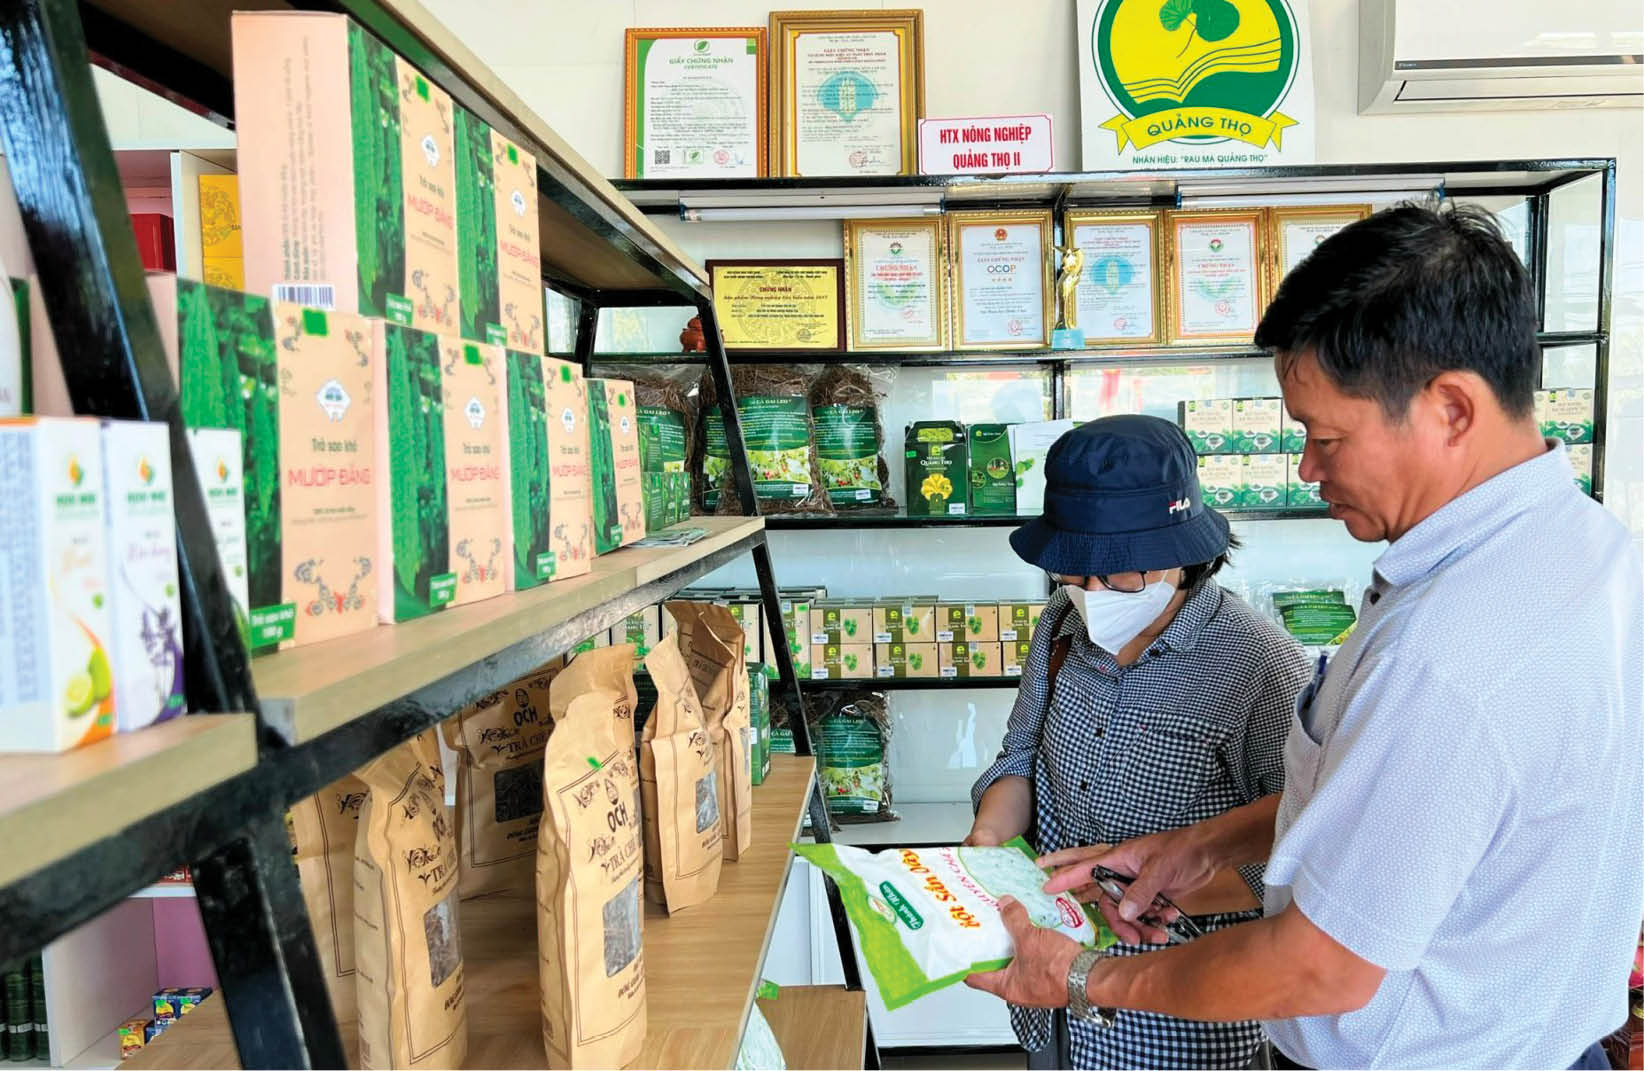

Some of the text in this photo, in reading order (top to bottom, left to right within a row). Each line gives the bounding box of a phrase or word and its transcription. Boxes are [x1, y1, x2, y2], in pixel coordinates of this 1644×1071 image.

[940, 123, 1032, 144] HTX NÔNG NGHIỆP
[1147, 112, 1252, 137] QUẢNG THỌ
[952, 148, 988, 170] QUẢNG
[991, 152, 1011, 170] THỌ
[987, 263, 1016, 273] OCOP
[1168, 497, 1190, 515] FILA
[513, 705, 537, 727] OCH
[607, 801, 629, 833] OCH
